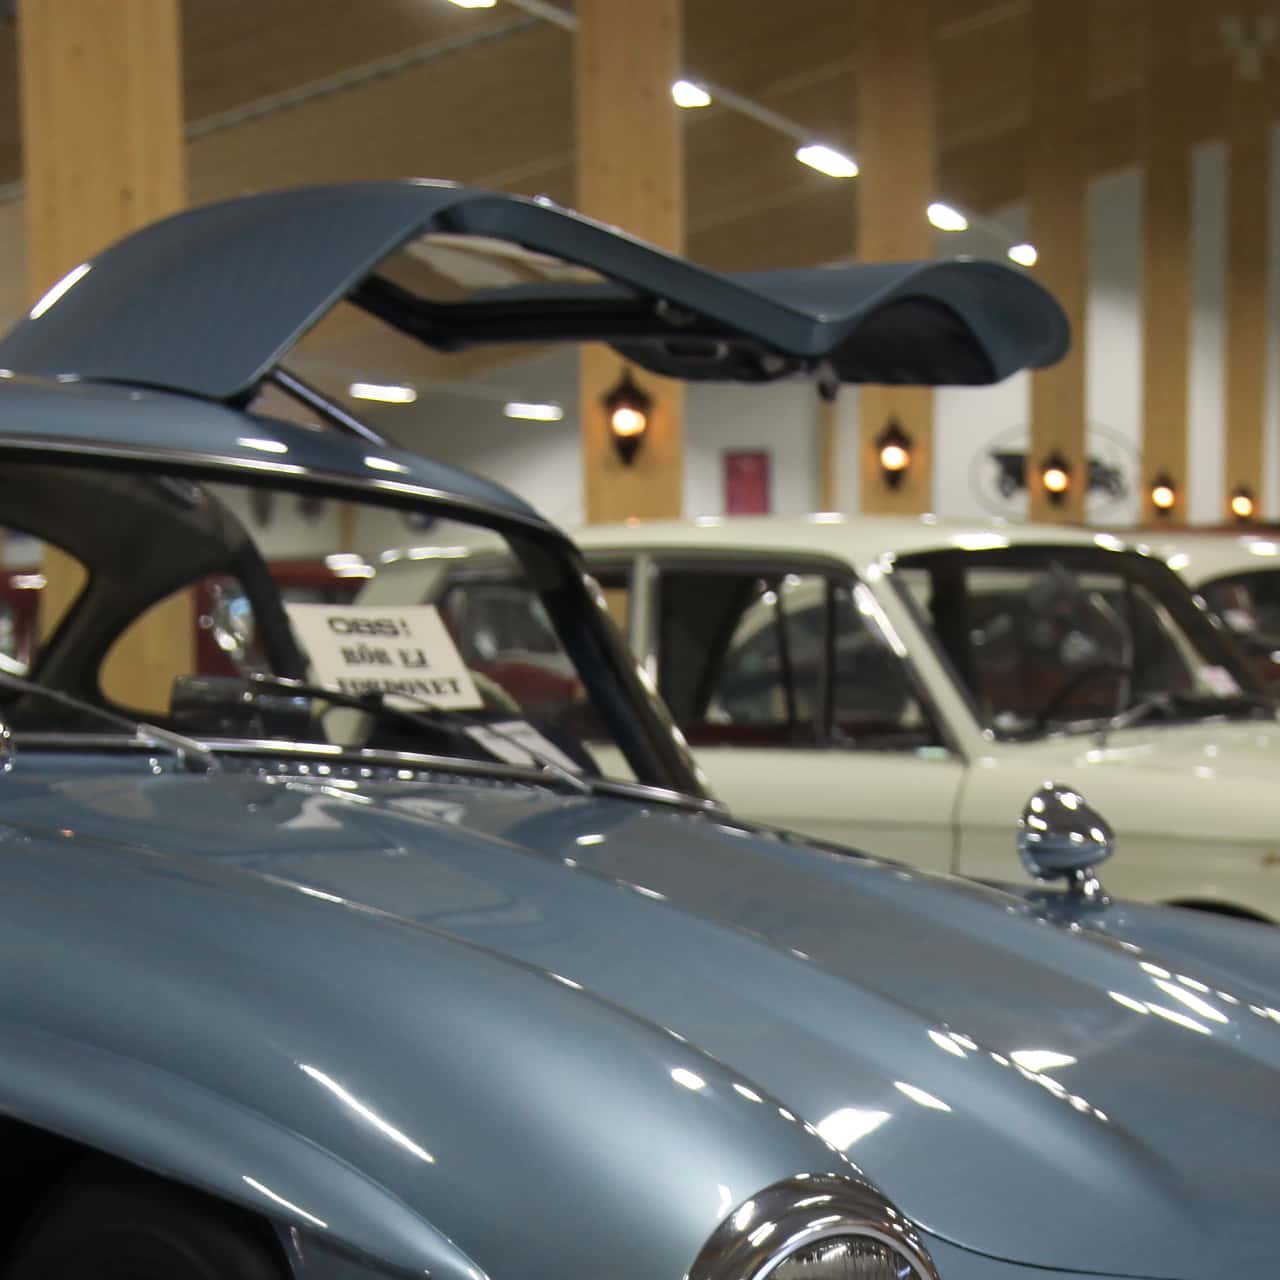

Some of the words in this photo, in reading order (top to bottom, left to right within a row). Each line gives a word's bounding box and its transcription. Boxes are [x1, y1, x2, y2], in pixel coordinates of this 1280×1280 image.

[328, 617, 411, 637] OBS!
[341, 643, 393, 665] RÖR
[398, 648, 429, 668] EJ
